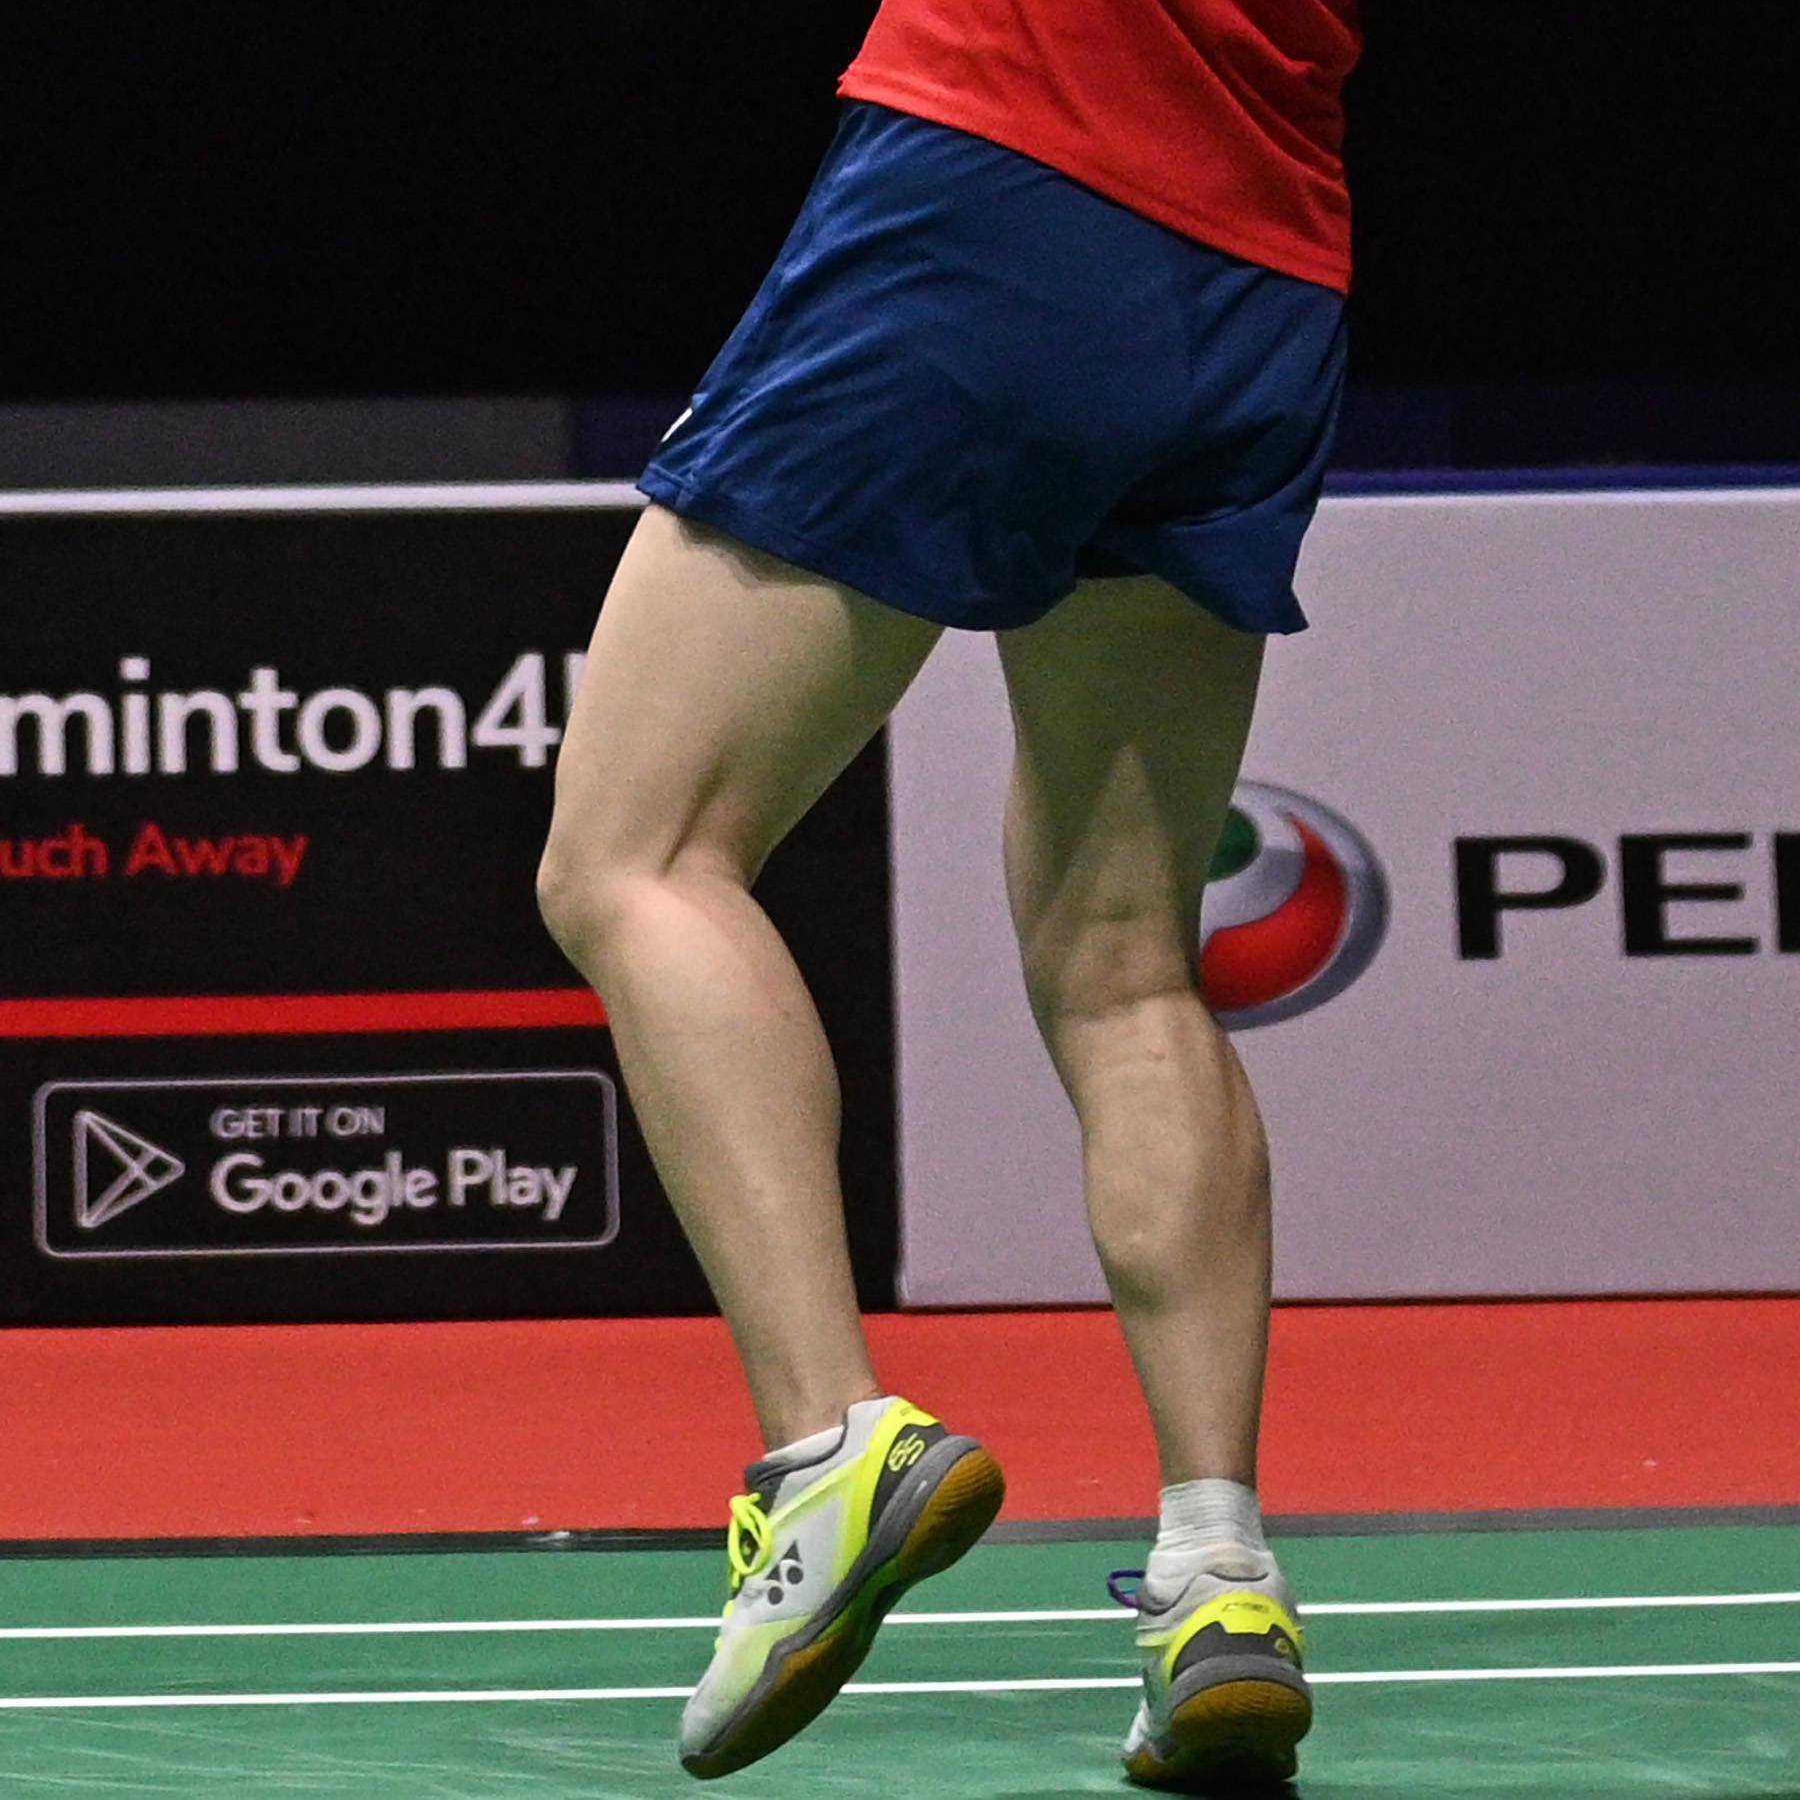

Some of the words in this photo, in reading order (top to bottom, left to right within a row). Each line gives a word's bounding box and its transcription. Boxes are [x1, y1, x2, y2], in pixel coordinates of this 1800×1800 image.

[125, 822, 308, 887] Away
[210, 1107, 281, 1139] GET
[288, 1107, 323, 1138] IT
[324, 1106, 386, 1136] ON
[209, 1149, 439, 1227] Google
[447, 1148, 579, 1222] Play
